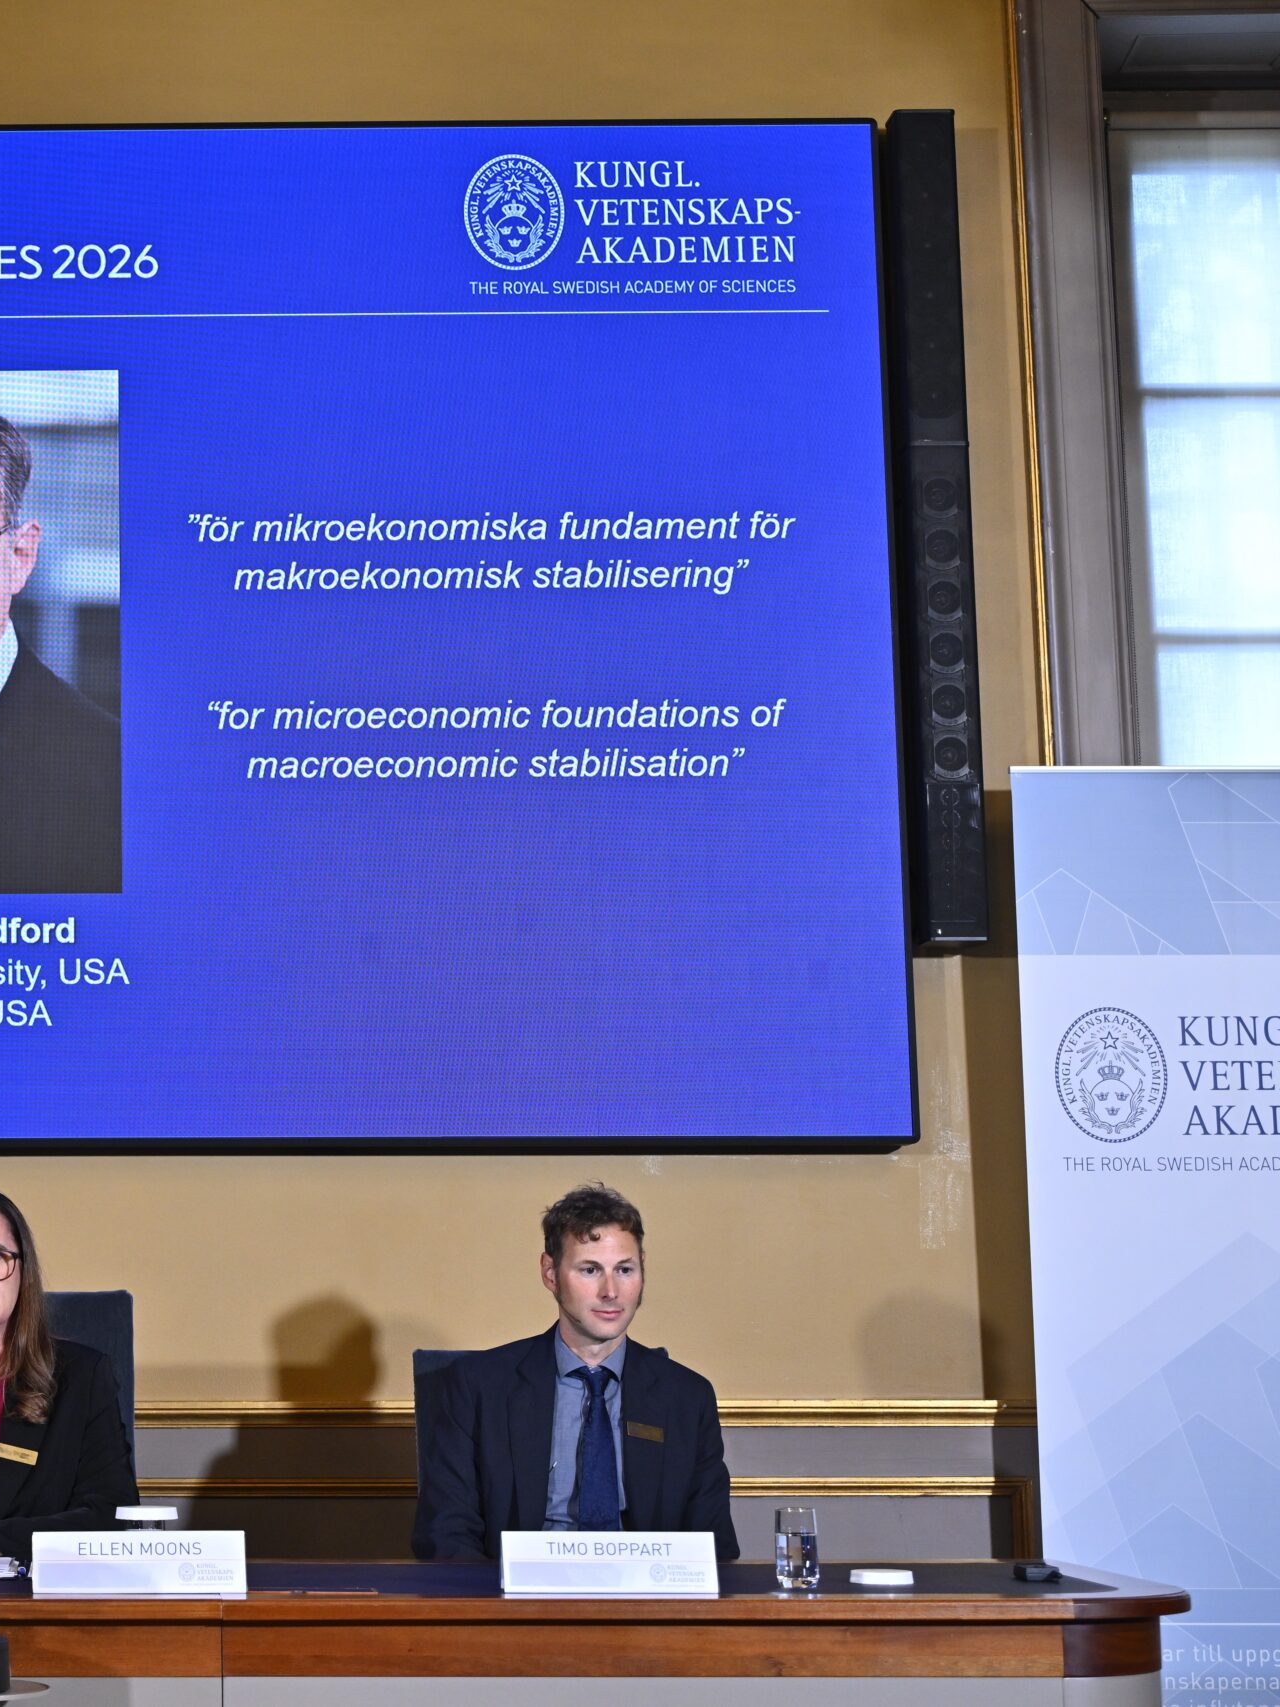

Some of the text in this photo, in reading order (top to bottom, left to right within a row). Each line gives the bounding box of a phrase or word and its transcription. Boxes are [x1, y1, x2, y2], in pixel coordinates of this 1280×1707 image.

[574, 160, 700, 188] KUNGL.
[472, 159, 559, 238] VETENSKAPSAKADEMIEN
[574, 197, 801, 226] VETENSKAPS-
[52, 243, 159, 279] 2026
[575, 235, 796, 264] AKADEMIEN
[469, 279, 796, 295] THE ROYAL SWEDISH ACADEMY OF SCIENCES
[187, 510, 797, 542] ”för mikroekonomiska fundament för
[234, 558, 750, 595] makroekonomisk stabilisering”
[207, 698, 787, 730] “for microeconomic foundations of
[246, 747, 746, 779] macroeconomic stabilisation”
[59, 958, 130, 985] USA
[1064, 1014, 1160, 1105] VETENSKAPSAKADEMIEN
[1178, 1060, 1280, 1092] VETE
[1063, 1156, 1096, 1172] THE
[1100, 1156, 1153, 1172] ROYAL
[1157, 1156, 1233, 1172] SWEDISH
[78, 1541, 202, 1556] ELLEN MOONS
[546, 1541, 672, 1557] TIMO BOPPART
[1192, 1644, 1223, 1662] till
